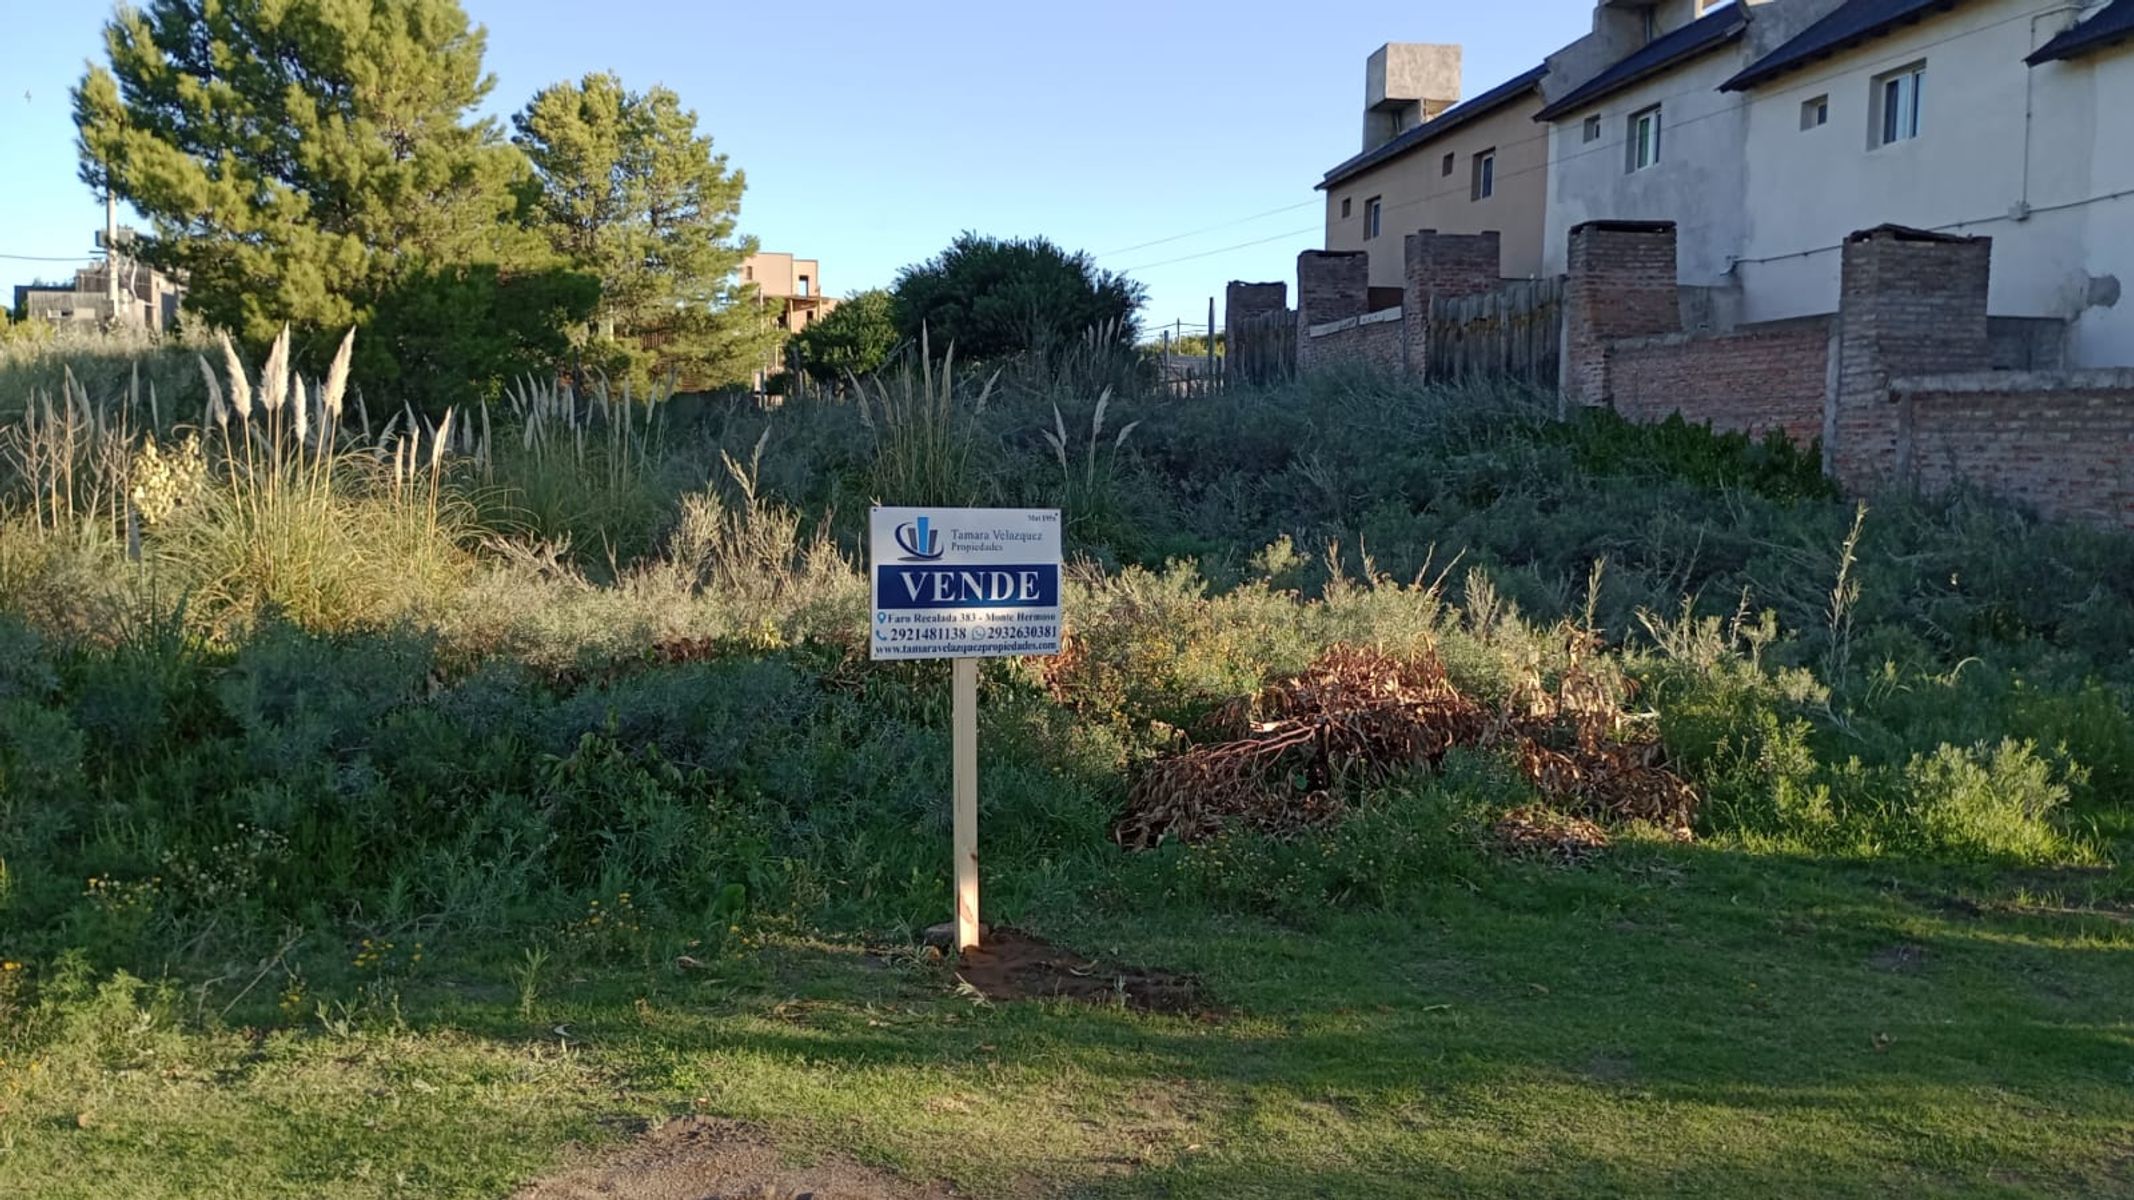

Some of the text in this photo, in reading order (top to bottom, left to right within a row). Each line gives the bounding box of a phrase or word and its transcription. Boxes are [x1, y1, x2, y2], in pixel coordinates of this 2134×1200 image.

[951, 529, 1042, 543] Tamara Velazquez
[951, 542, 1003, 553] Propiedades
[900, 571, 1039, 602] VENDE
[888, 614, 911, 623] Faro
[914, 613, 957, 623] Recalada
[986, 612, 1013, 622] Monte
[1017, 612, 1056, 621] Hermoso
[890, 625, 1057, 641] 2921481138 2932630381
[875, 641, 1057, 655] www.tamaravelazquezpropiedades.com
